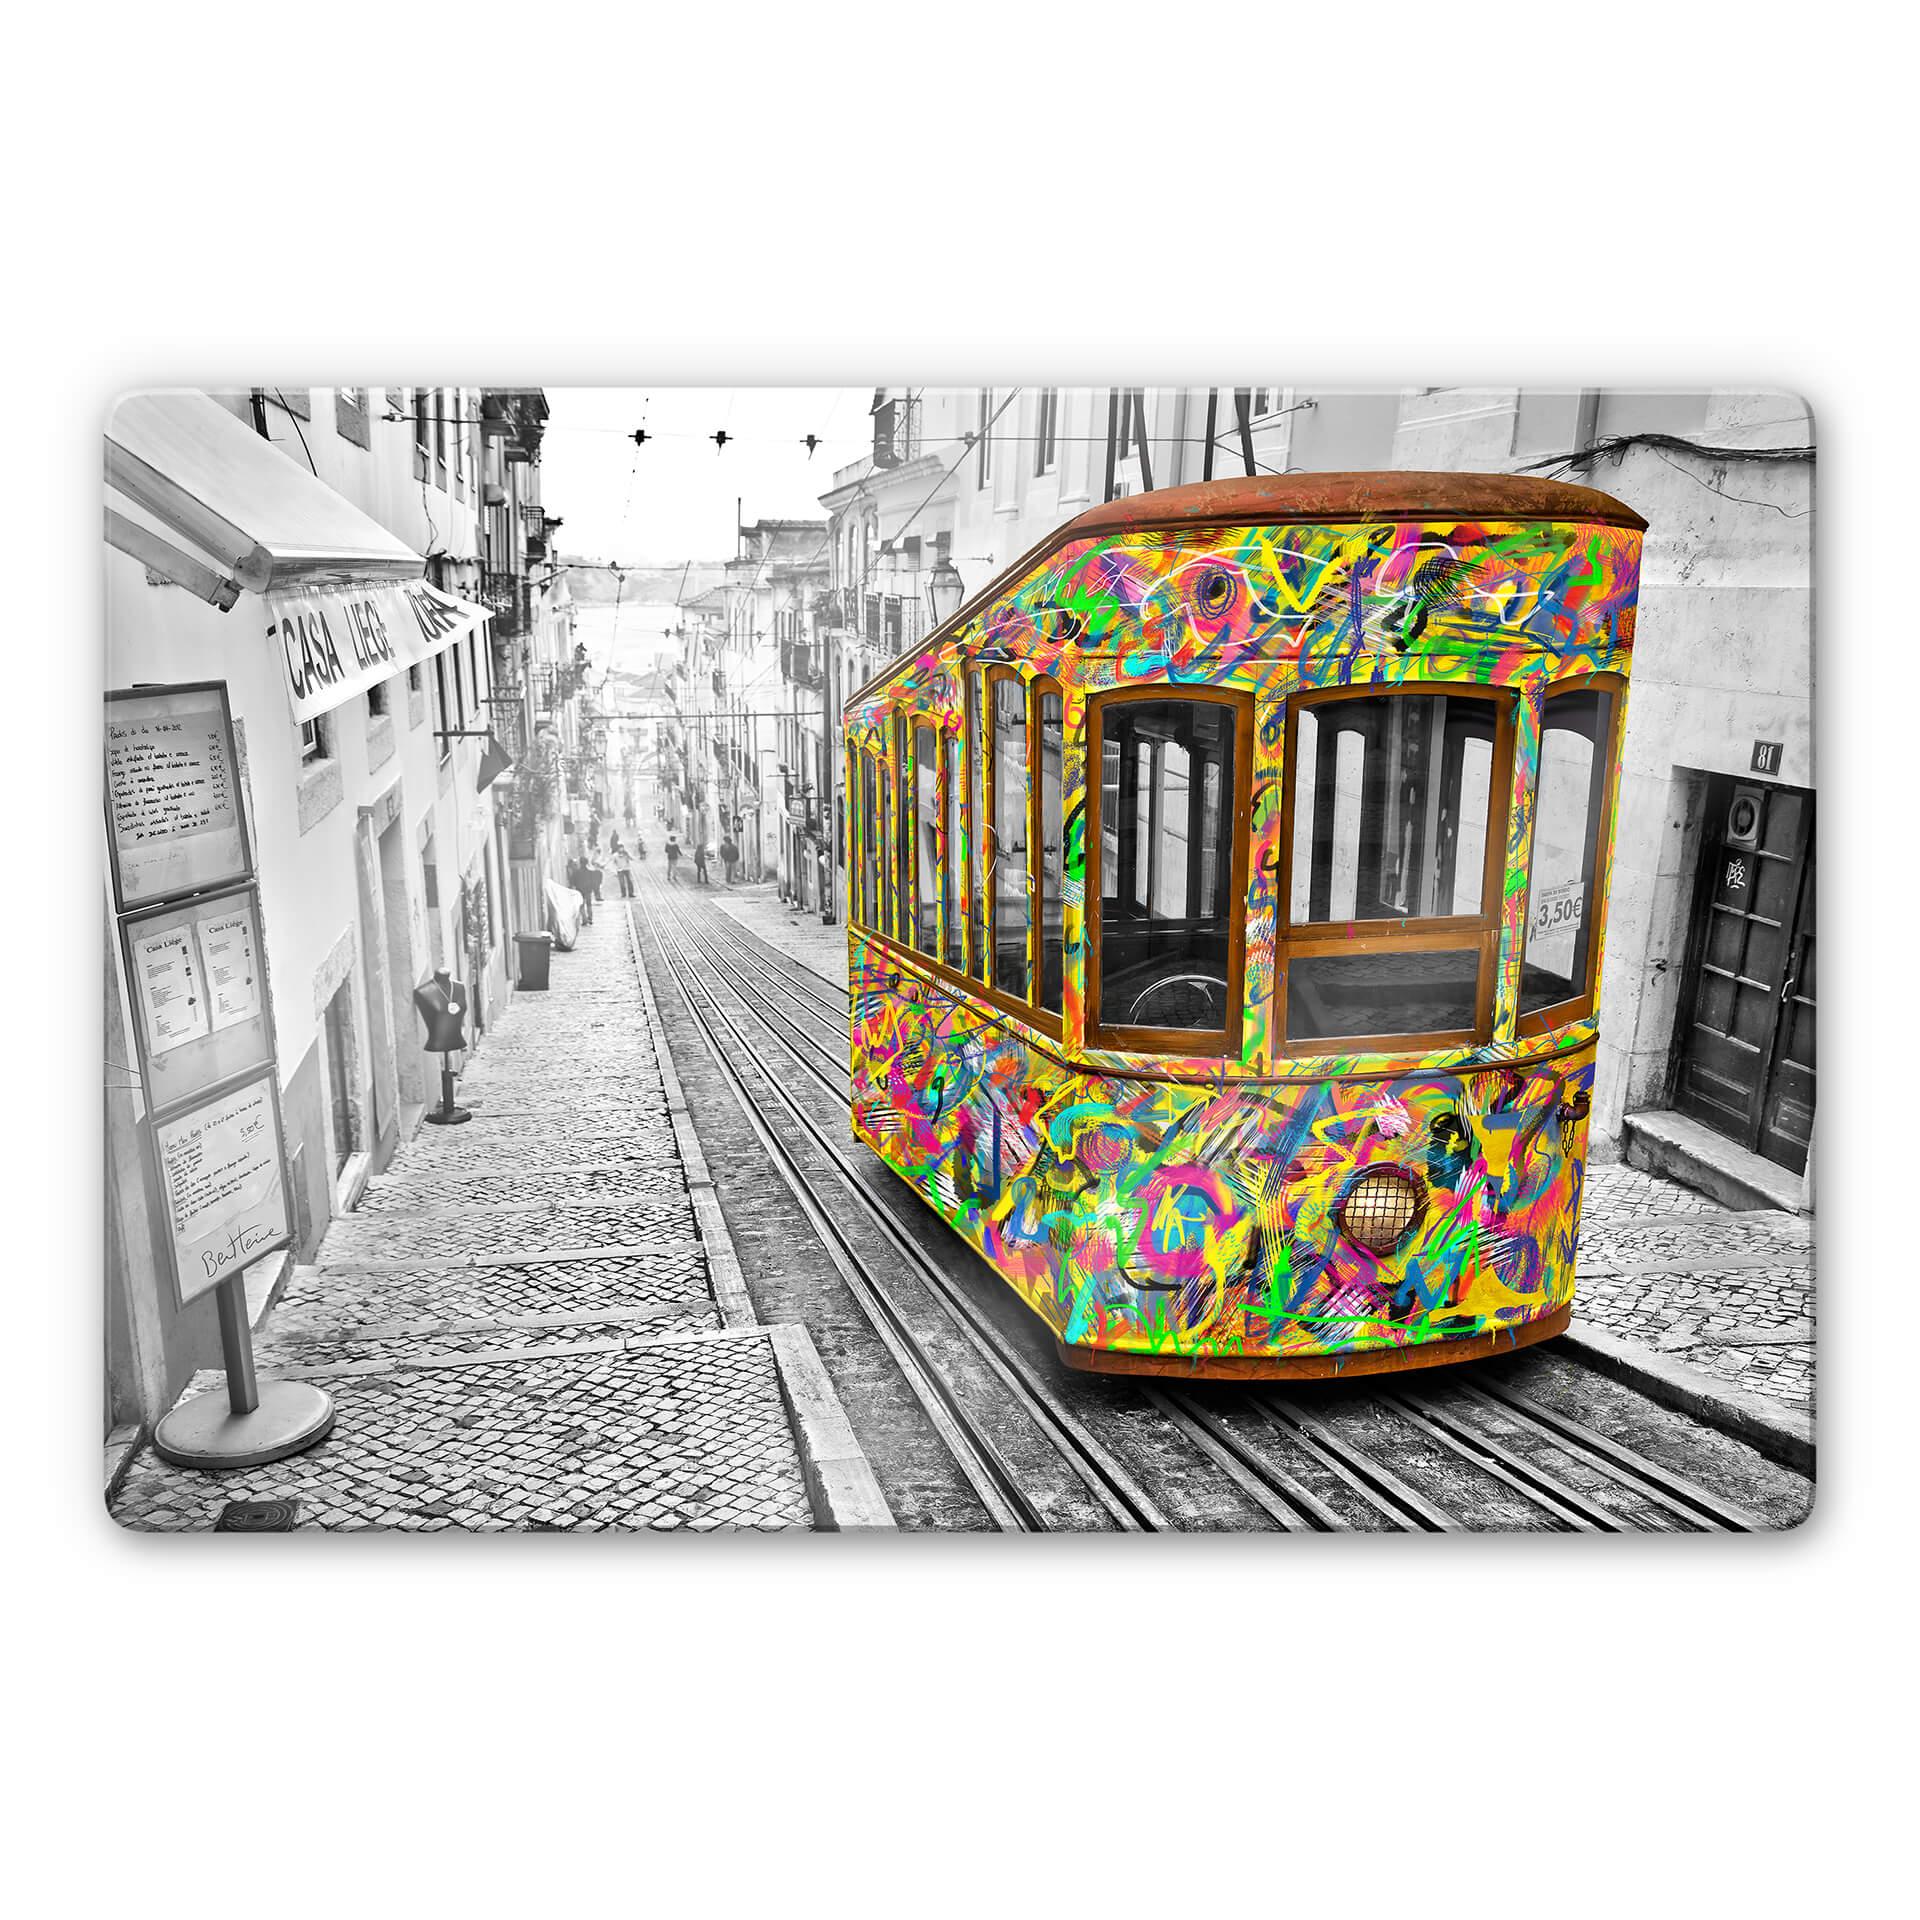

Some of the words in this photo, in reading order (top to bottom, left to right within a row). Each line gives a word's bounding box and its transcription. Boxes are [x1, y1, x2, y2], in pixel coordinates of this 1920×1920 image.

[282, 611, 345, 700] CASA
[1757, 744, 1774, 771] 81
[1538, 896, 1583, 929] 3,50€
[208, 926, 224, 934] Casa
[146, 944, 162, 953] Casa
